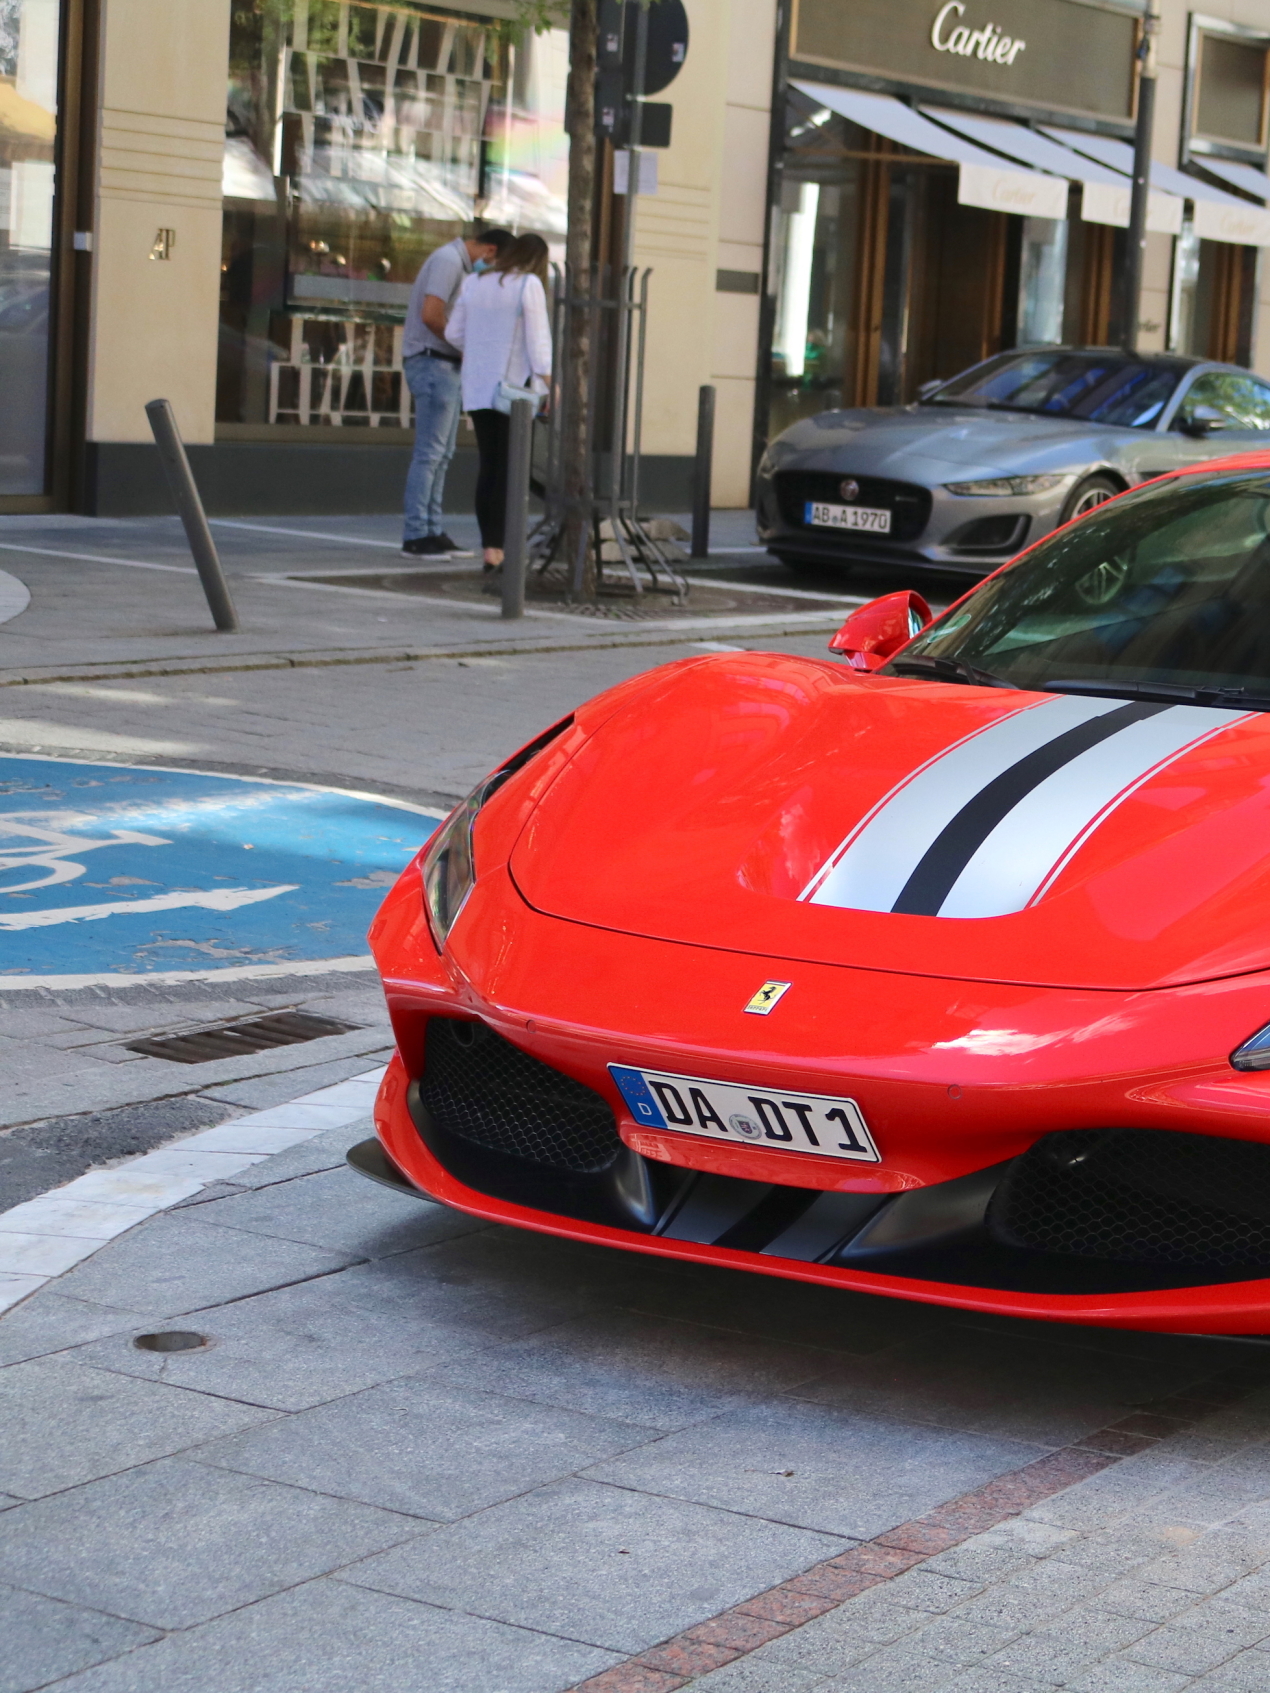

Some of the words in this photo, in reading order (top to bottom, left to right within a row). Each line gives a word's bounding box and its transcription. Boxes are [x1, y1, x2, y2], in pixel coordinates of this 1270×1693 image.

[931, 0, 1026, 65] Cartier
[813, 506, 830, 524] AB
[840, 509, 848, 524] A
[852, 511, 888, 530] 1970
[638, 1102, 652, 1116] D
[648, 1080, 728, 1133] DA
